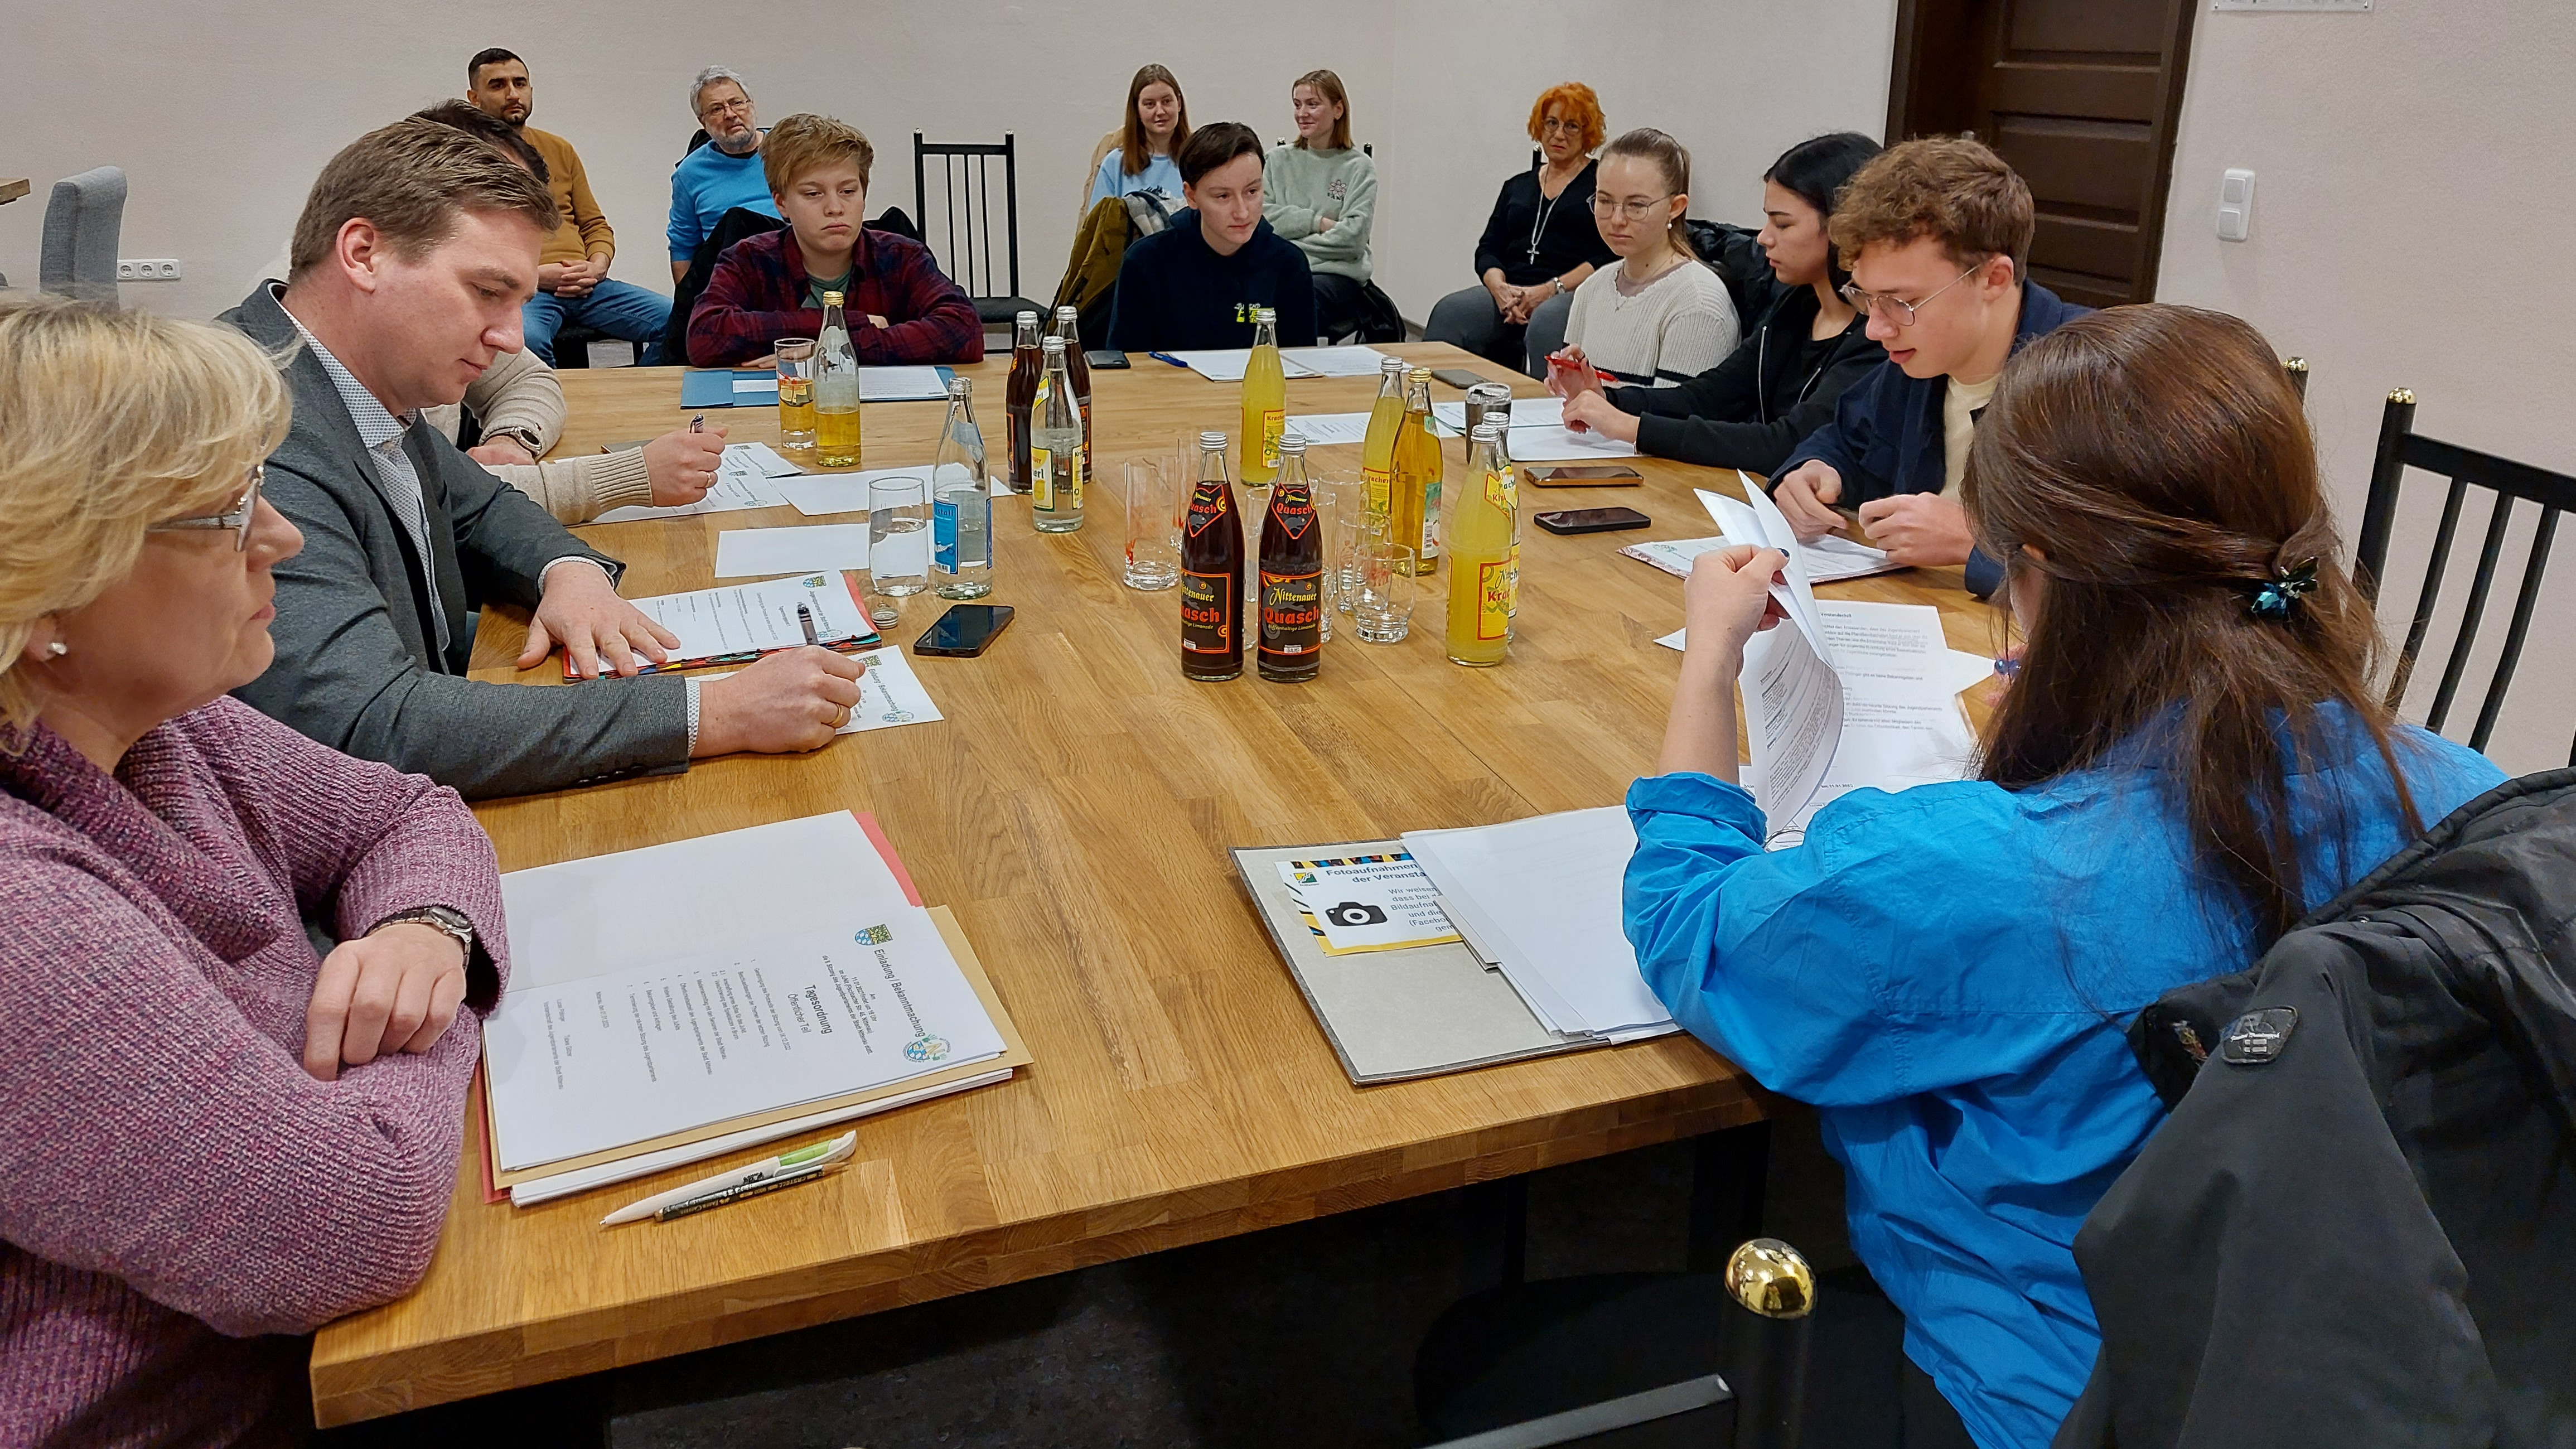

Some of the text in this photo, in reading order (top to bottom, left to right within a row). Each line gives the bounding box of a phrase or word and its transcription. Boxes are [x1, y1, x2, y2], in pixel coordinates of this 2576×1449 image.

[1277, 503, 1312, 514] Quasch
[1269, 586, 1317, 606] Nittenauer
[1264, 605, 1320, 624] Quasch
[1326, 863, 1418, 876] Fotoaufnahmen
[873, 949, 895, 979] Einladung
[891, 982, 926, 1037] Bekanntmachung
[787, 993, 812, 1034] Öffentlicher Teil
[804, 984, 833, 1035] Tagesordnung
